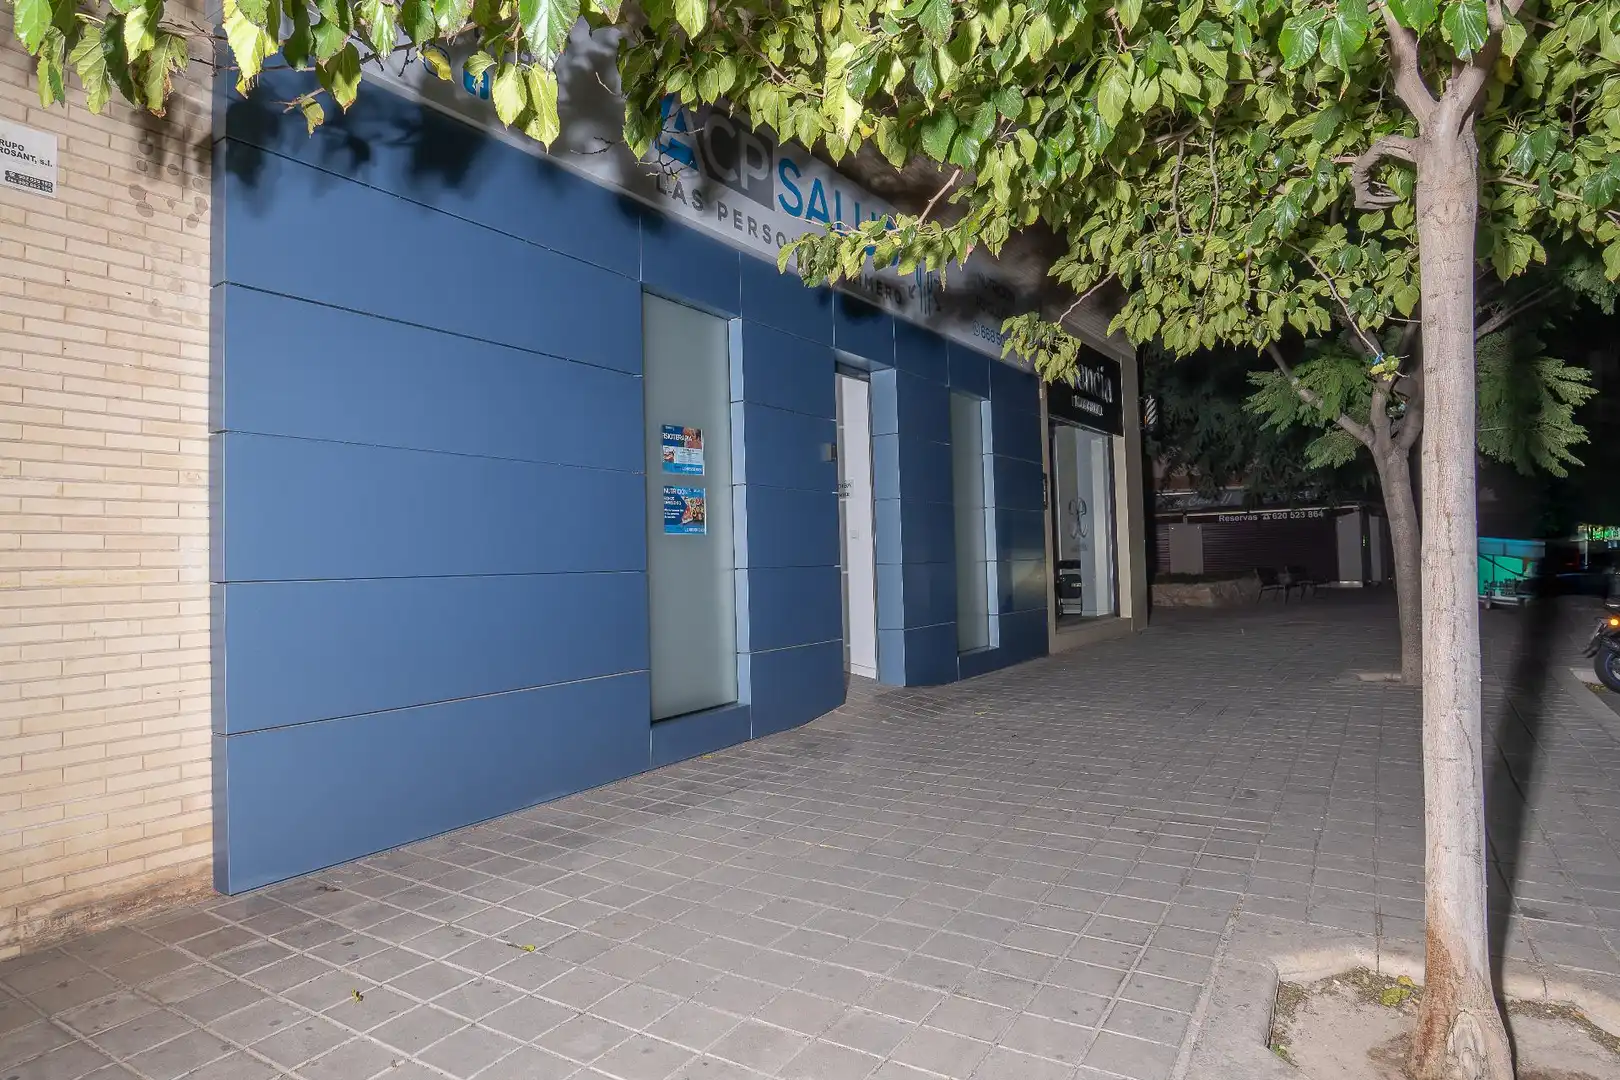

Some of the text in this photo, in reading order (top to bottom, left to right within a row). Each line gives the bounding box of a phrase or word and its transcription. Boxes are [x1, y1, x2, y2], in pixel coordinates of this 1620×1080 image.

[656, 174, 704, 212] LAS
[717, 201, 799, 255] PERSO
[778, 158, 899, 266] SALU
[1218, 509, 1324, 522] Reservas 620 523 864
